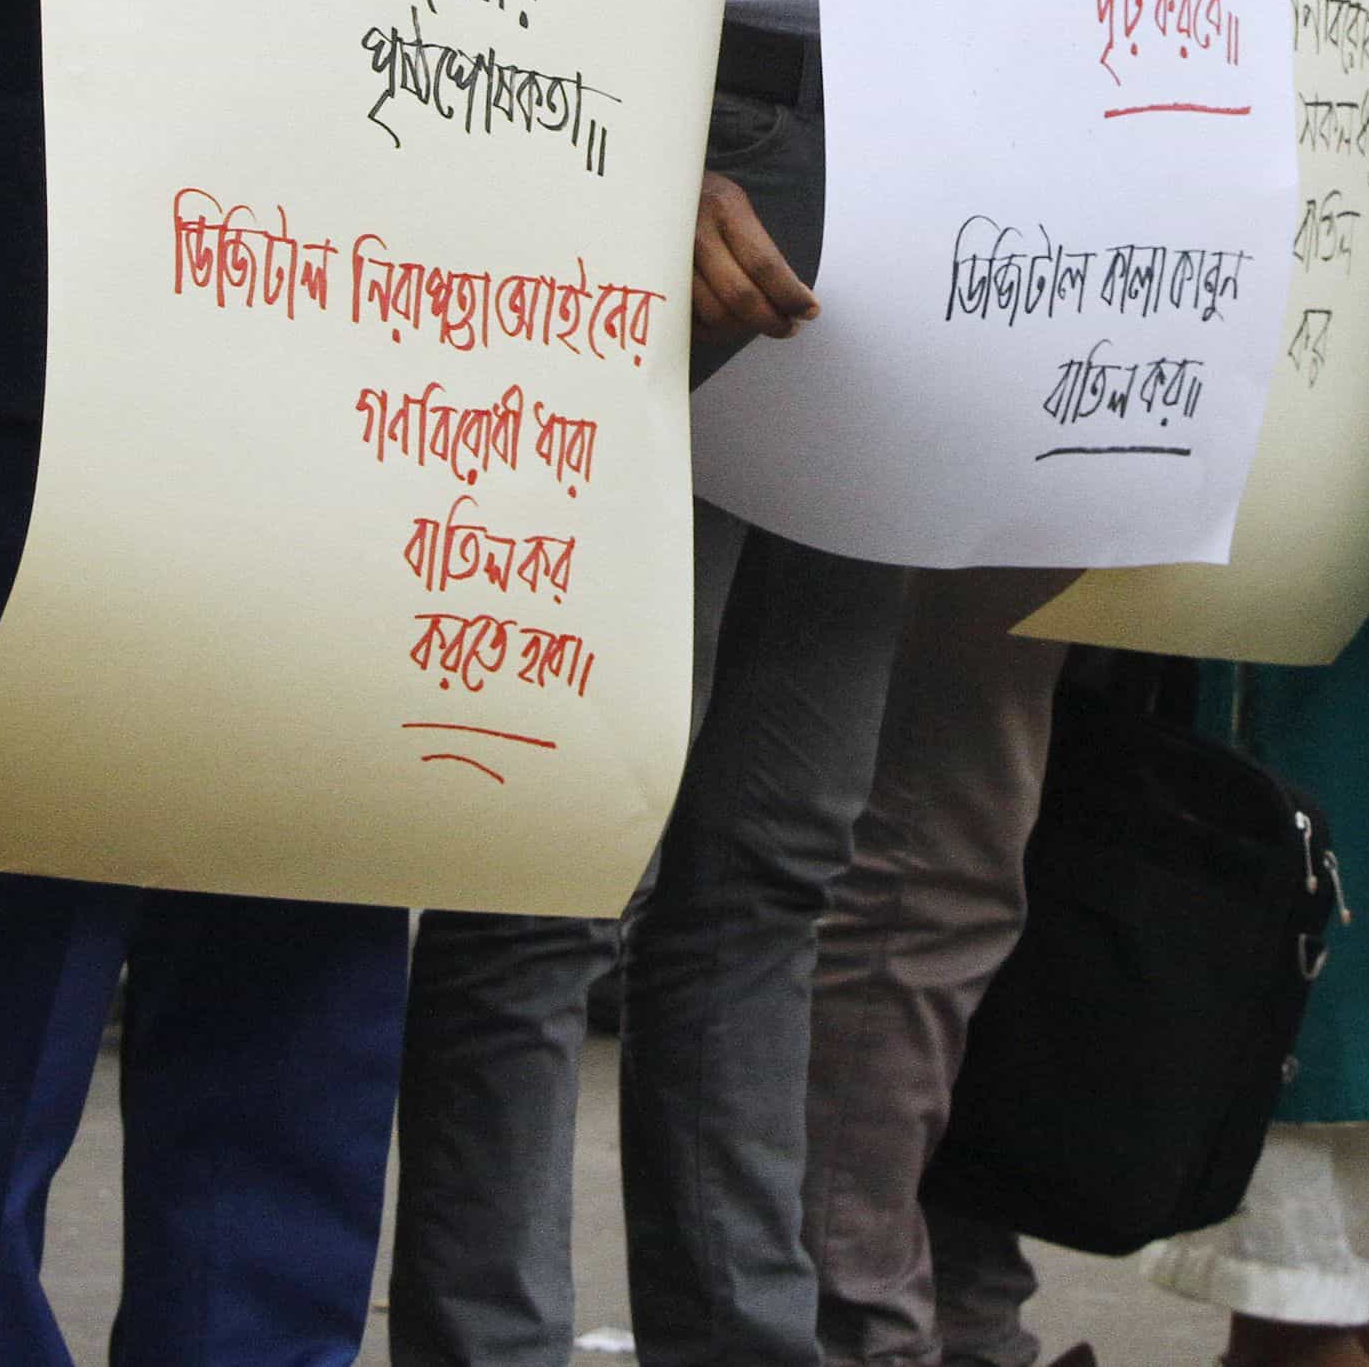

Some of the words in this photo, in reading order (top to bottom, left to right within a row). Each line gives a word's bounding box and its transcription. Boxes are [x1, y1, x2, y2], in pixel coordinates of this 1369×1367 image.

[173, 187, 339, 320] ডিজিটাল
[351, 233, 492, 352] নিরাপত্তা
[494, 257, 667, 367] আইনের
[945, 215, 1098, 327] ডিজিটাল
[1042, 339, 1141, 426] বাতিল
[532, 401, 598, 499] ধারা
